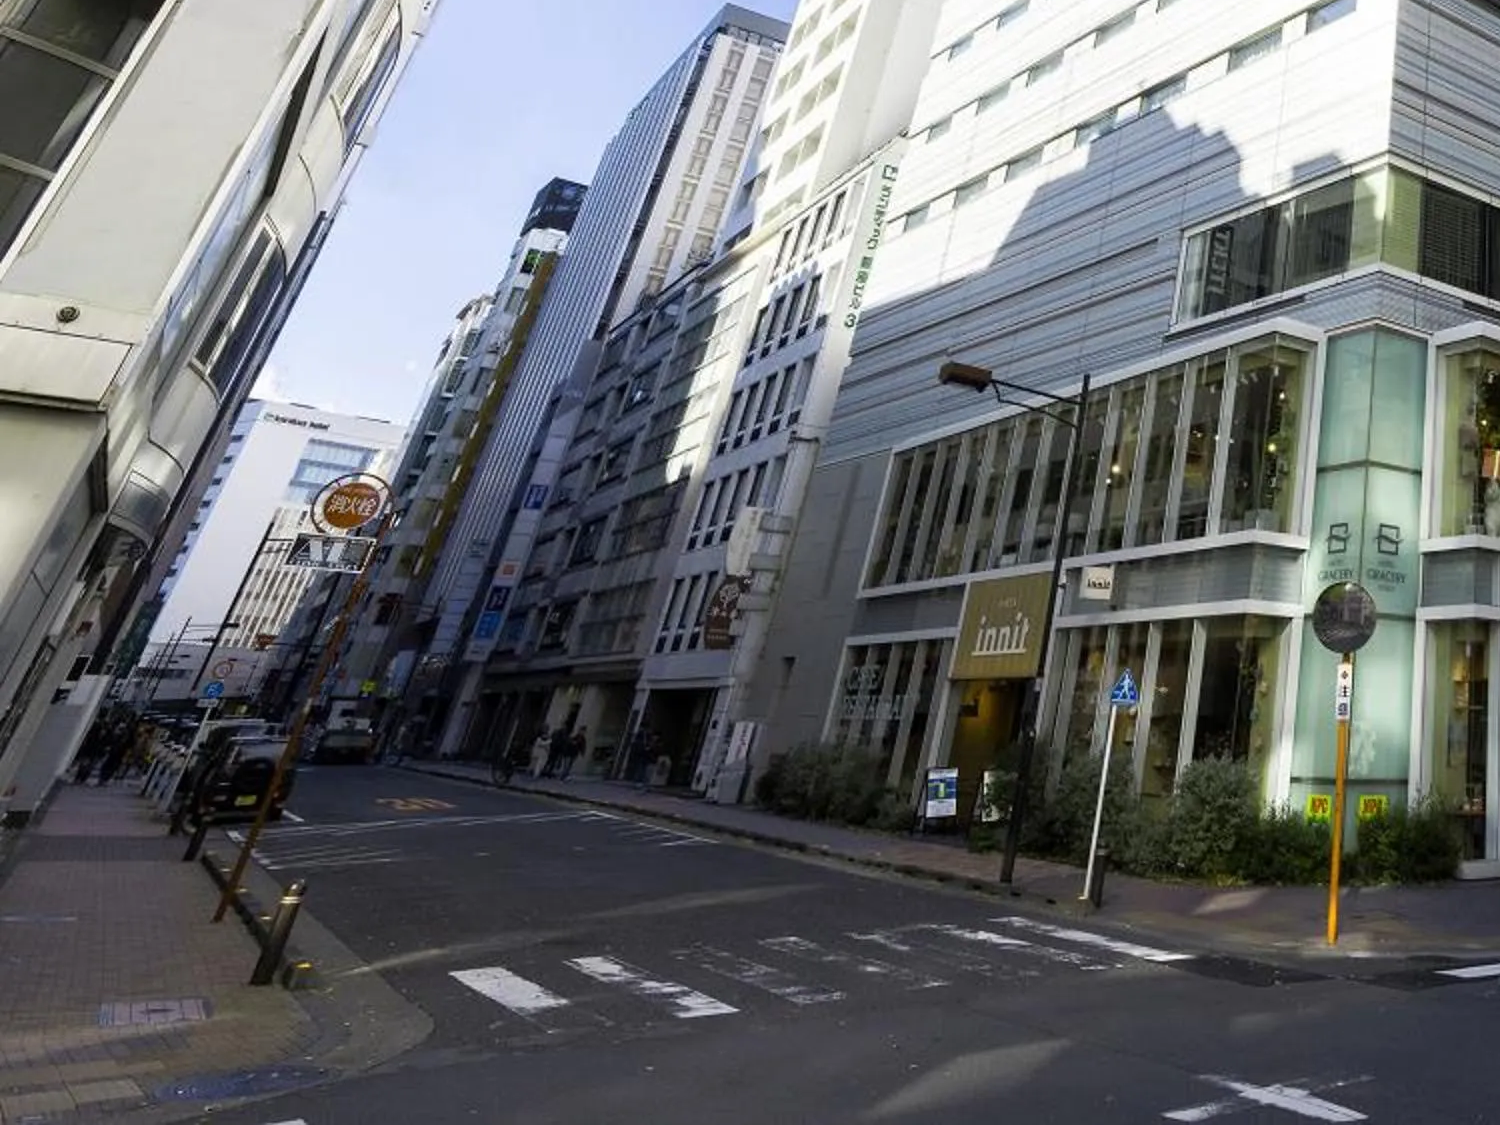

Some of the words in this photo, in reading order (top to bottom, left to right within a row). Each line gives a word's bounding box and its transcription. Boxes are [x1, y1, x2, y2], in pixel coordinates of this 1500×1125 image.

[327, 494, 378, 516] 消火栓
[971, 613, 1030, 656] innit
